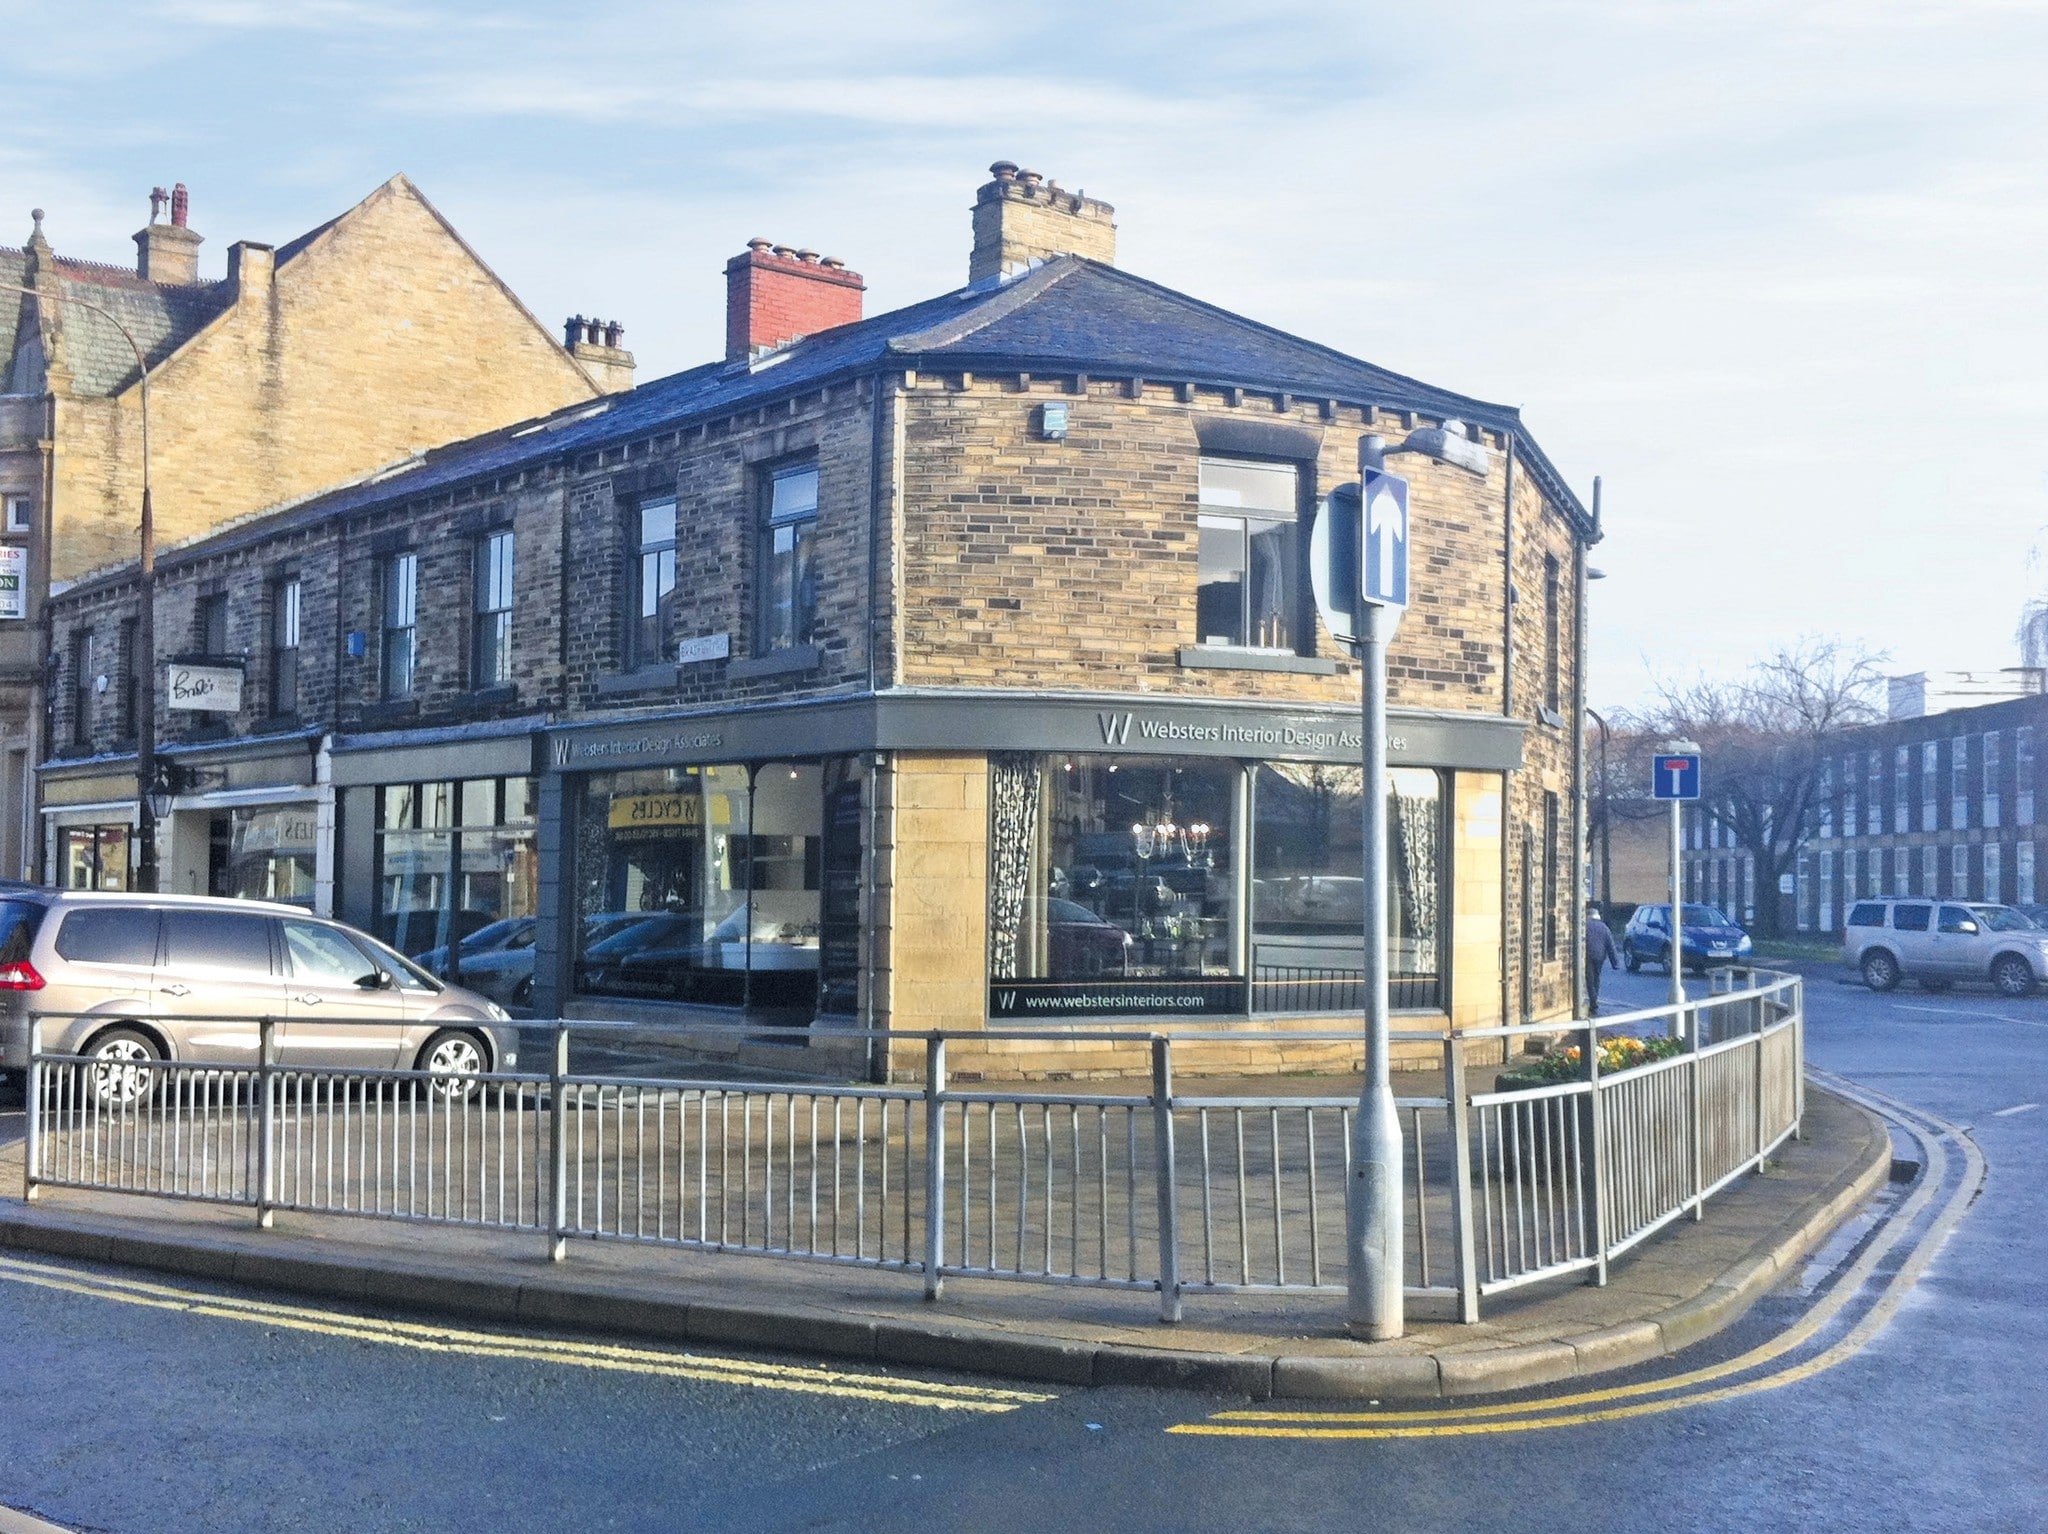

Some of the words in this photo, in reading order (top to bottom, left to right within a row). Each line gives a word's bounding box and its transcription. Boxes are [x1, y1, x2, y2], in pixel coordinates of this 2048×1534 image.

[1098, 712, 1133, 745] W
[1140, 720, 1219, 742] Websters
[1222, 723, 1282, 744] Interior
[1283, 727, 1336, 750] Design
[1338, 730, 1408, 750] Asstes
[610, 741, 641, 755] Interior
[642, 737, 671, 755] Design
[998, 990, 1016, 1010] W
[1025, 993, 1205, 1009] www.webstersinteriors.com
